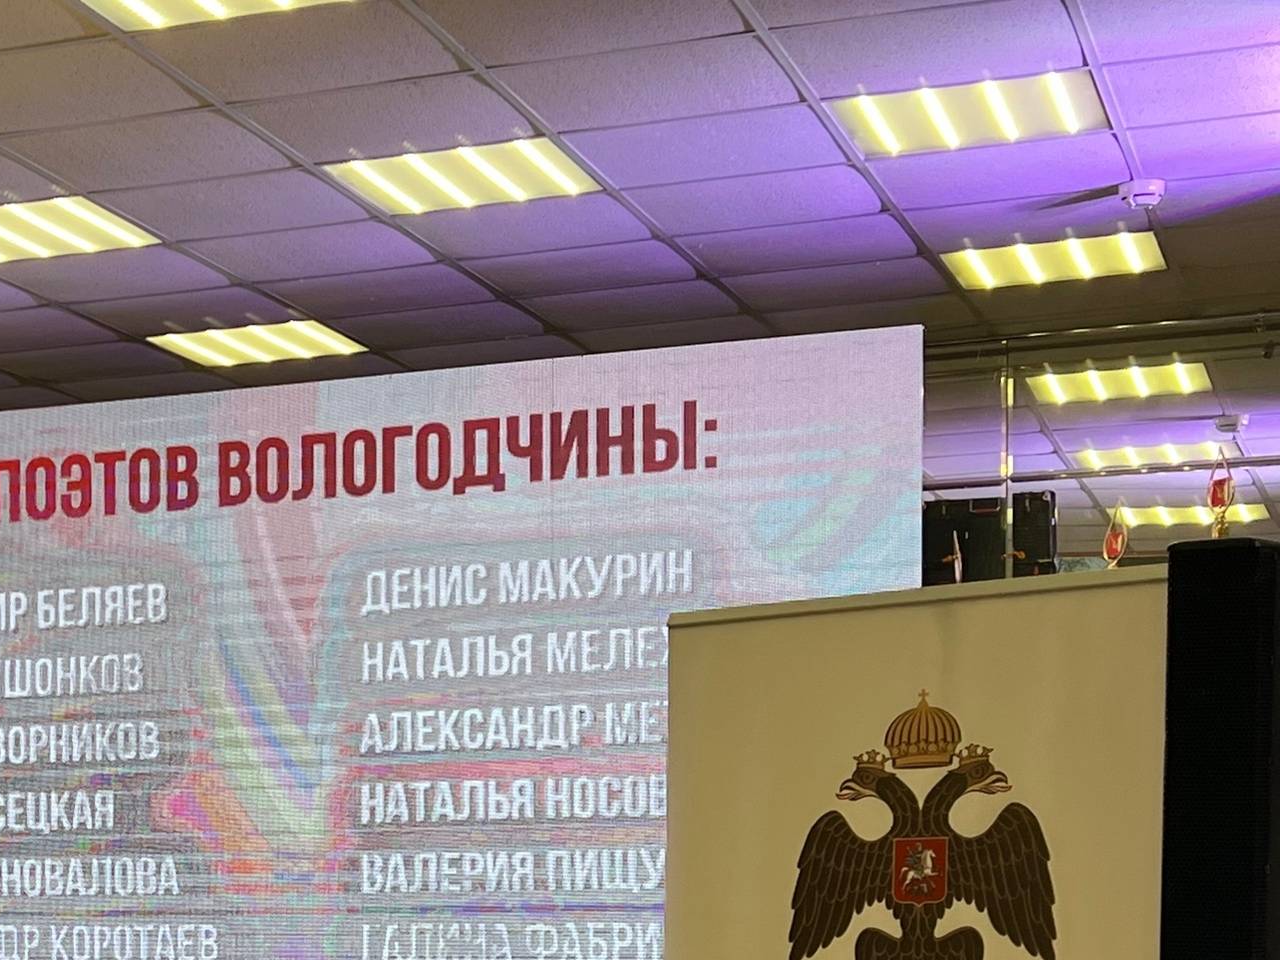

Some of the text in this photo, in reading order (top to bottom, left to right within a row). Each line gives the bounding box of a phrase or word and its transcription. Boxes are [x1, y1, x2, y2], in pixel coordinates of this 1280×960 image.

[218, 401, 720, 507] ВОЛОГОДЧИНЫ:
[37, 583, 167, 630] БЕЛЯЕВ
[360, 549, 694, 617] ДЕНИС МАКУРИН
[361, 633, 533, 684] НАТАЛЬЯ
[360, 700, 668, 754] АЛЕКСАНДР МЕ
[361, 778, 535, 824] НАТАЛЬЯ
[361, 850, 535, 894] ВАЛЕРИЯ
